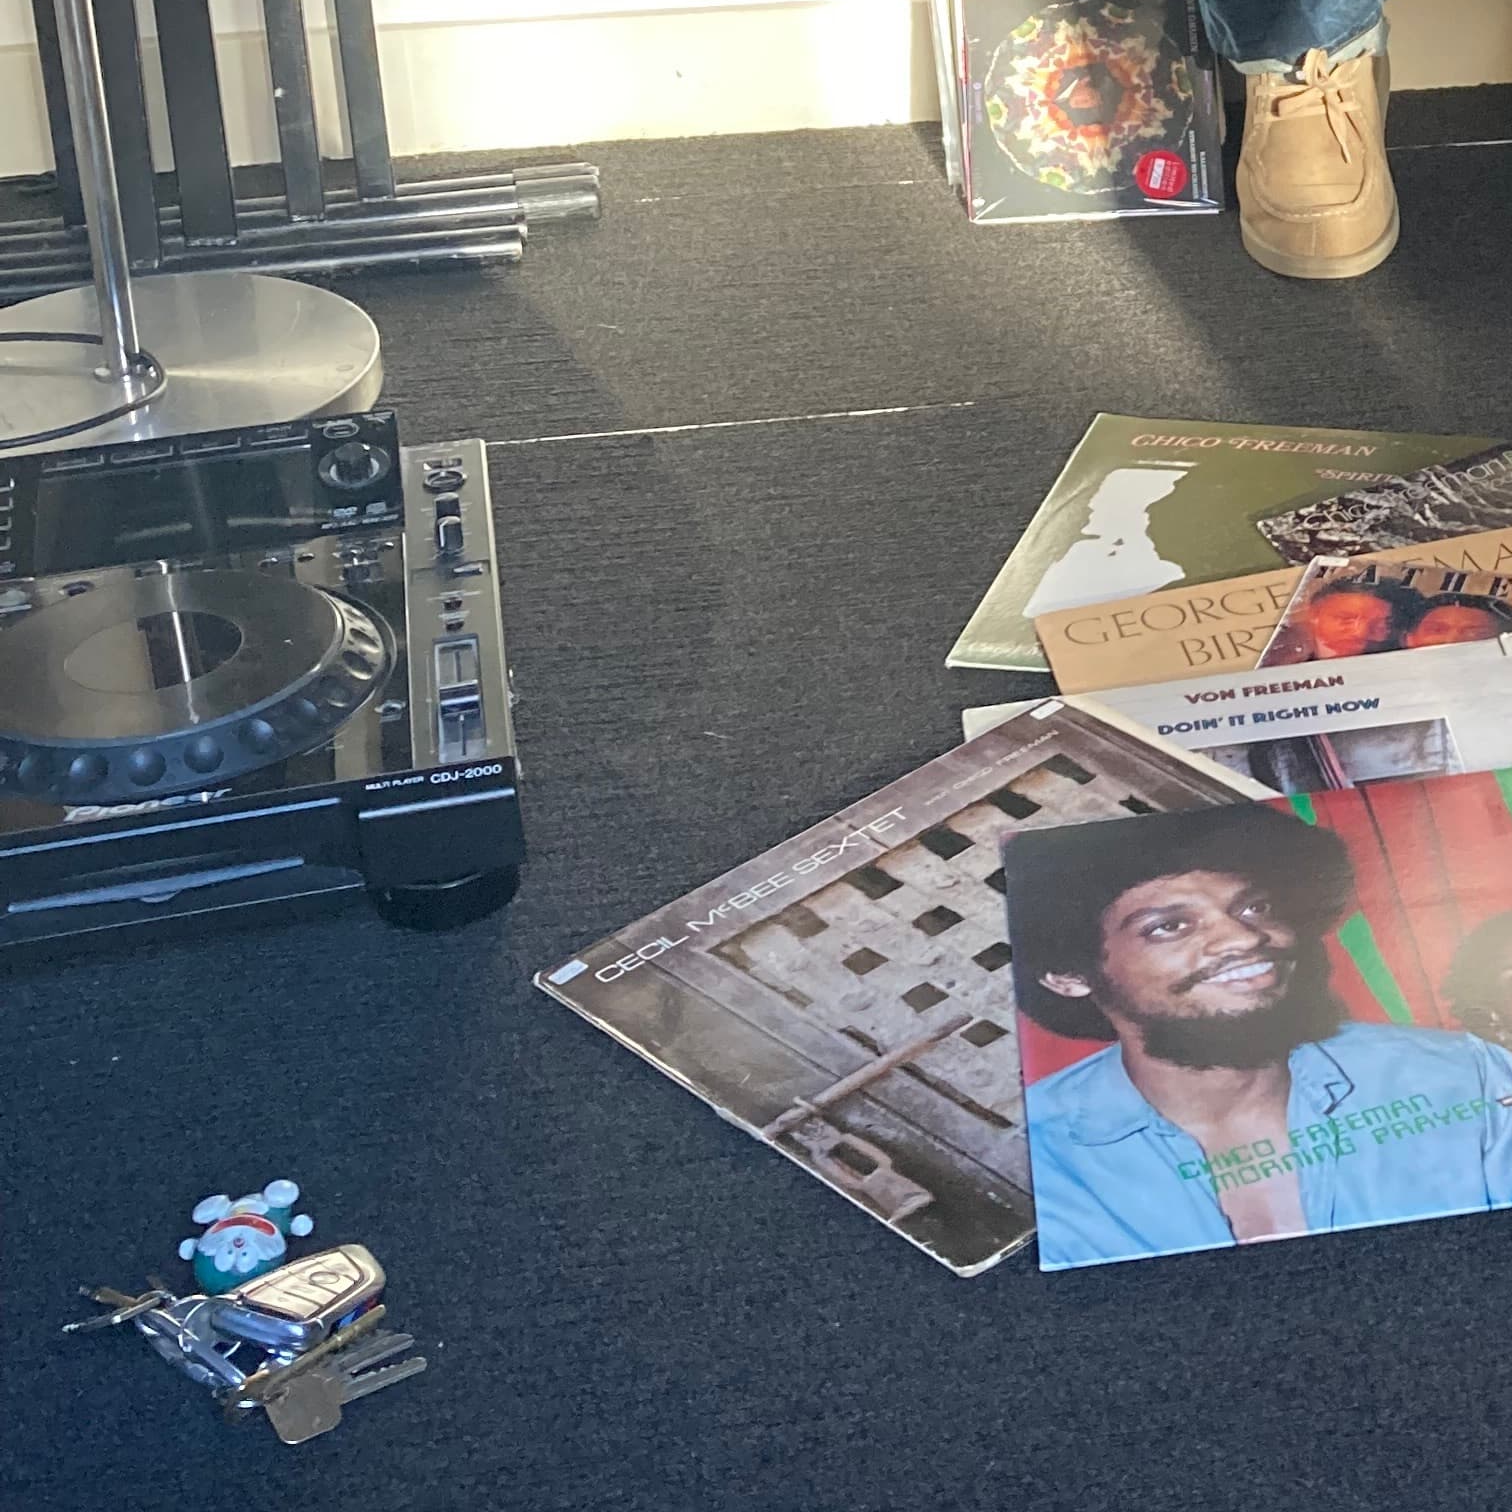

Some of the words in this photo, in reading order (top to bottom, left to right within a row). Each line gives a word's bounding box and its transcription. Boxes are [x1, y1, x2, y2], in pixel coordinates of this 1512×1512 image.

[1130, 433, 1221, 449] CHICO
[1227, 436, 1378, 457] FREEMAN
[1063, 581, 1291, 646] GEORGE
[1184, 686, 1236, 705] VON
[1242, 674, 1345, 697] FREEMAN
[1158, 716, 1224, 736] DOIN'
[1228, 713, 1246, 727] IT
[1253, 704, 1319, 724] RIGHT
[1325, 697, 1381, 715] NOW
[365, 780, 391, 791] MULTI
[392, 775, 425, 787] PLAYER
[429, 763, 503, 784] CDJ-2000
[63, 787, 232, 823] Pioneer
[594, 935, 690, 984] CECIL
[791, 805, 908, 876] SEXTET
[1177, 1138, 1276, 1181] CHICO
[1288, 1092, 1433, 1145] FREEMAN
[1208, 1137, 1358, 1194] MORNING
[1370, 1096, 1492, 1146] PRAYER
